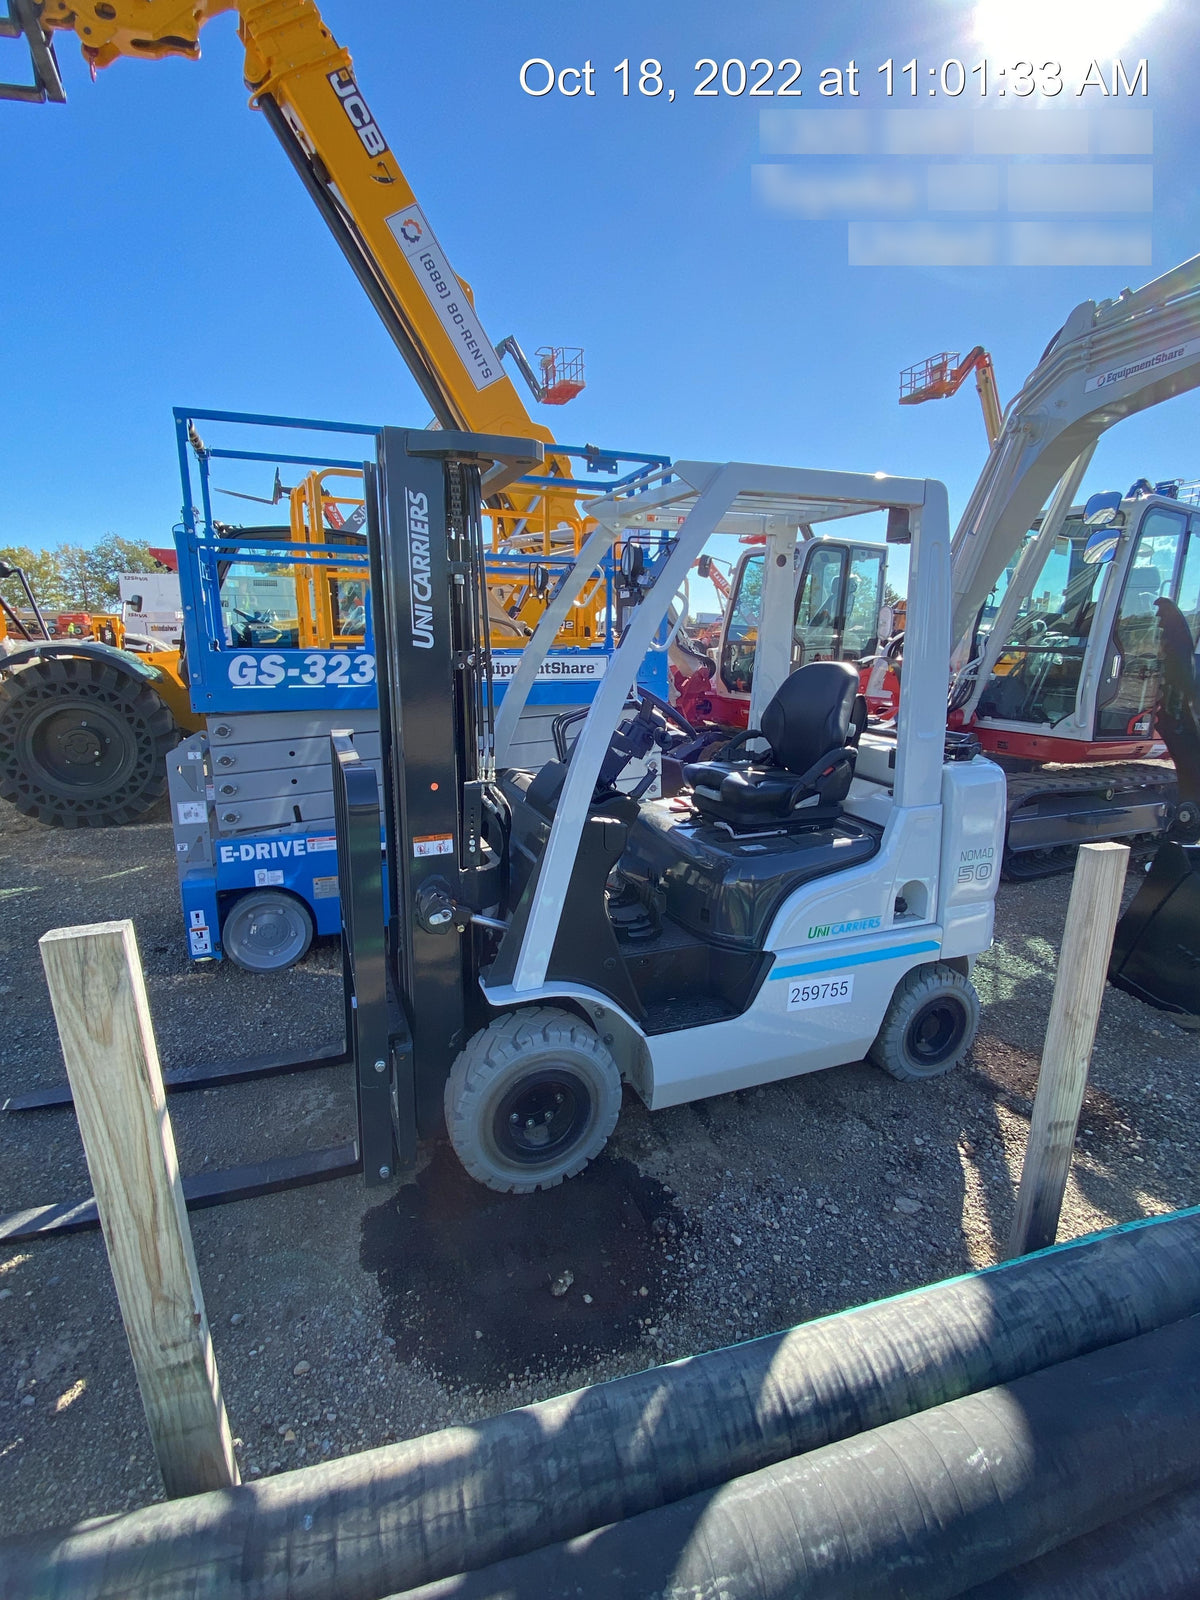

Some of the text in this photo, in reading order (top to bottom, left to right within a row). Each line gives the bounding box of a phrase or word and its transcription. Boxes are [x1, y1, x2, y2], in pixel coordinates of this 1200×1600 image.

[328, 71, 387, 157] JCB
[419, 252, 493, 380] (888) 80-RENTS
[1106, 347, 1185, 384] EquipmentShare
[228, 653, 377, 686] GS-323
[220, 839, 307, 864] E-DRIVE
[960, 847, 994, 862] NOMAD
[957, 862, 993, 884] 50
[790, 980, 849, 1004] 259755
